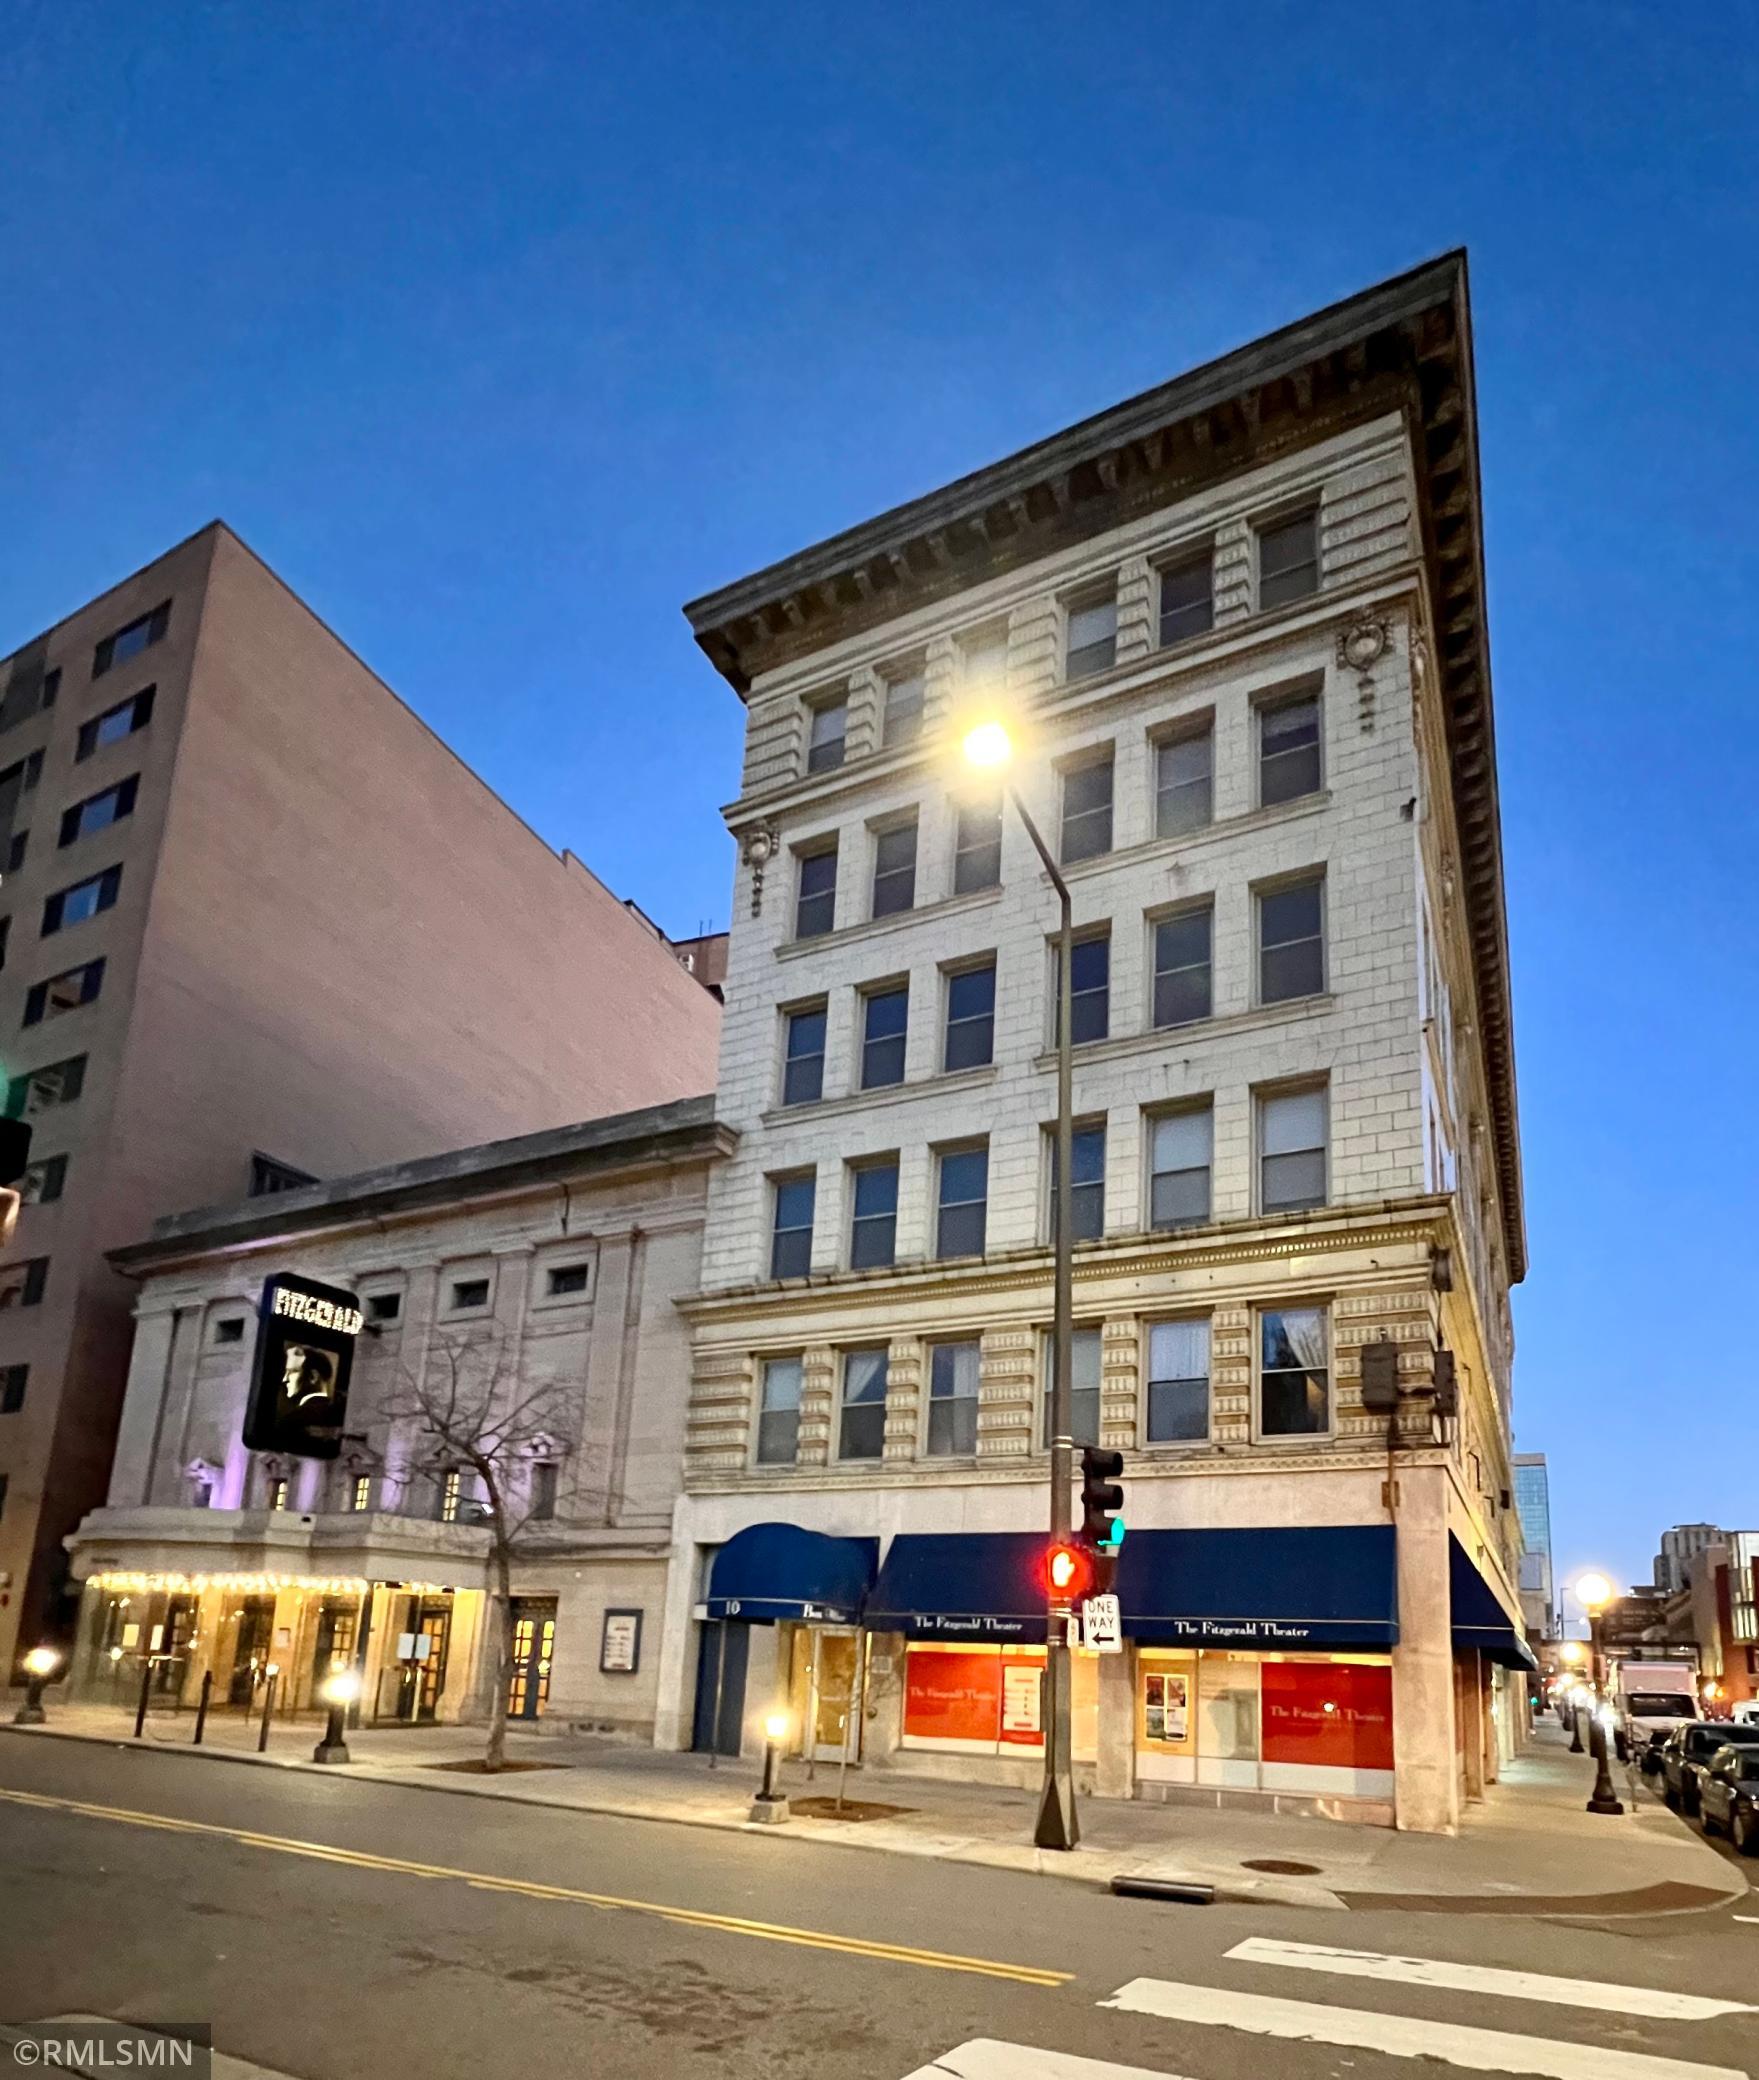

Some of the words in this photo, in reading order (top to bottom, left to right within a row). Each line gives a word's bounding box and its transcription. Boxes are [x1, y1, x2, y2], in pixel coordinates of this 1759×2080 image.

[272, 1287, 364, 1335] FITZGERALD
[725, 1600, 741, 1615] 10
[1088, 1601, 1113, 1613] ONE
[1088, 1616, 1114, 1628] WAY
[1174, 1620, 1198, 1634] The
[1202, 1621, 1256, 1636] Fitzgerald
[1261, 1622, 1309, 1636] Theater
